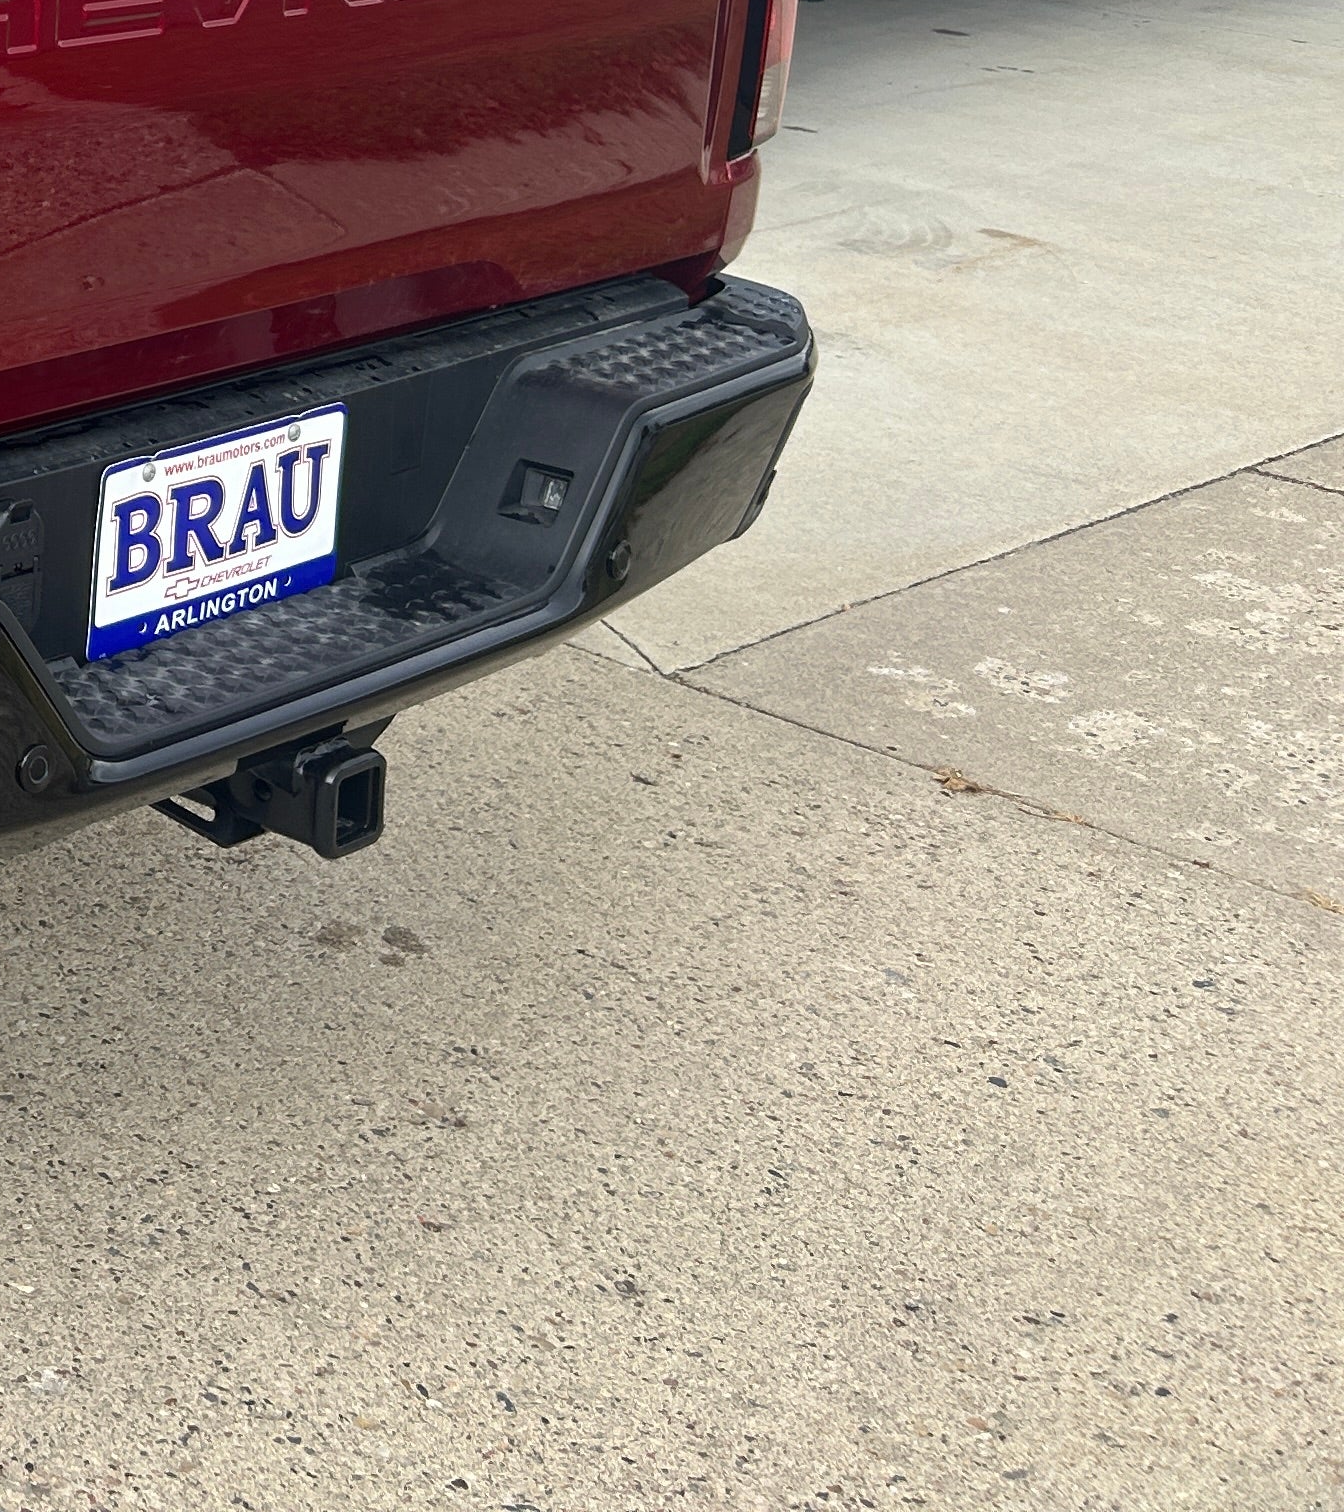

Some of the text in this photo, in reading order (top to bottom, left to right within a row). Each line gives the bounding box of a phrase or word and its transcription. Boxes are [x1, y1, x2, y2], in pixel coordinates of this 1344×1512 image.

[164, 434, 286, 476] www.braumotors.com
[106, 439, 332, 597] BRAU
[201, 555, 273, 588] CHEVROLET
[154, 578, 278, 635] ARLINGTON
